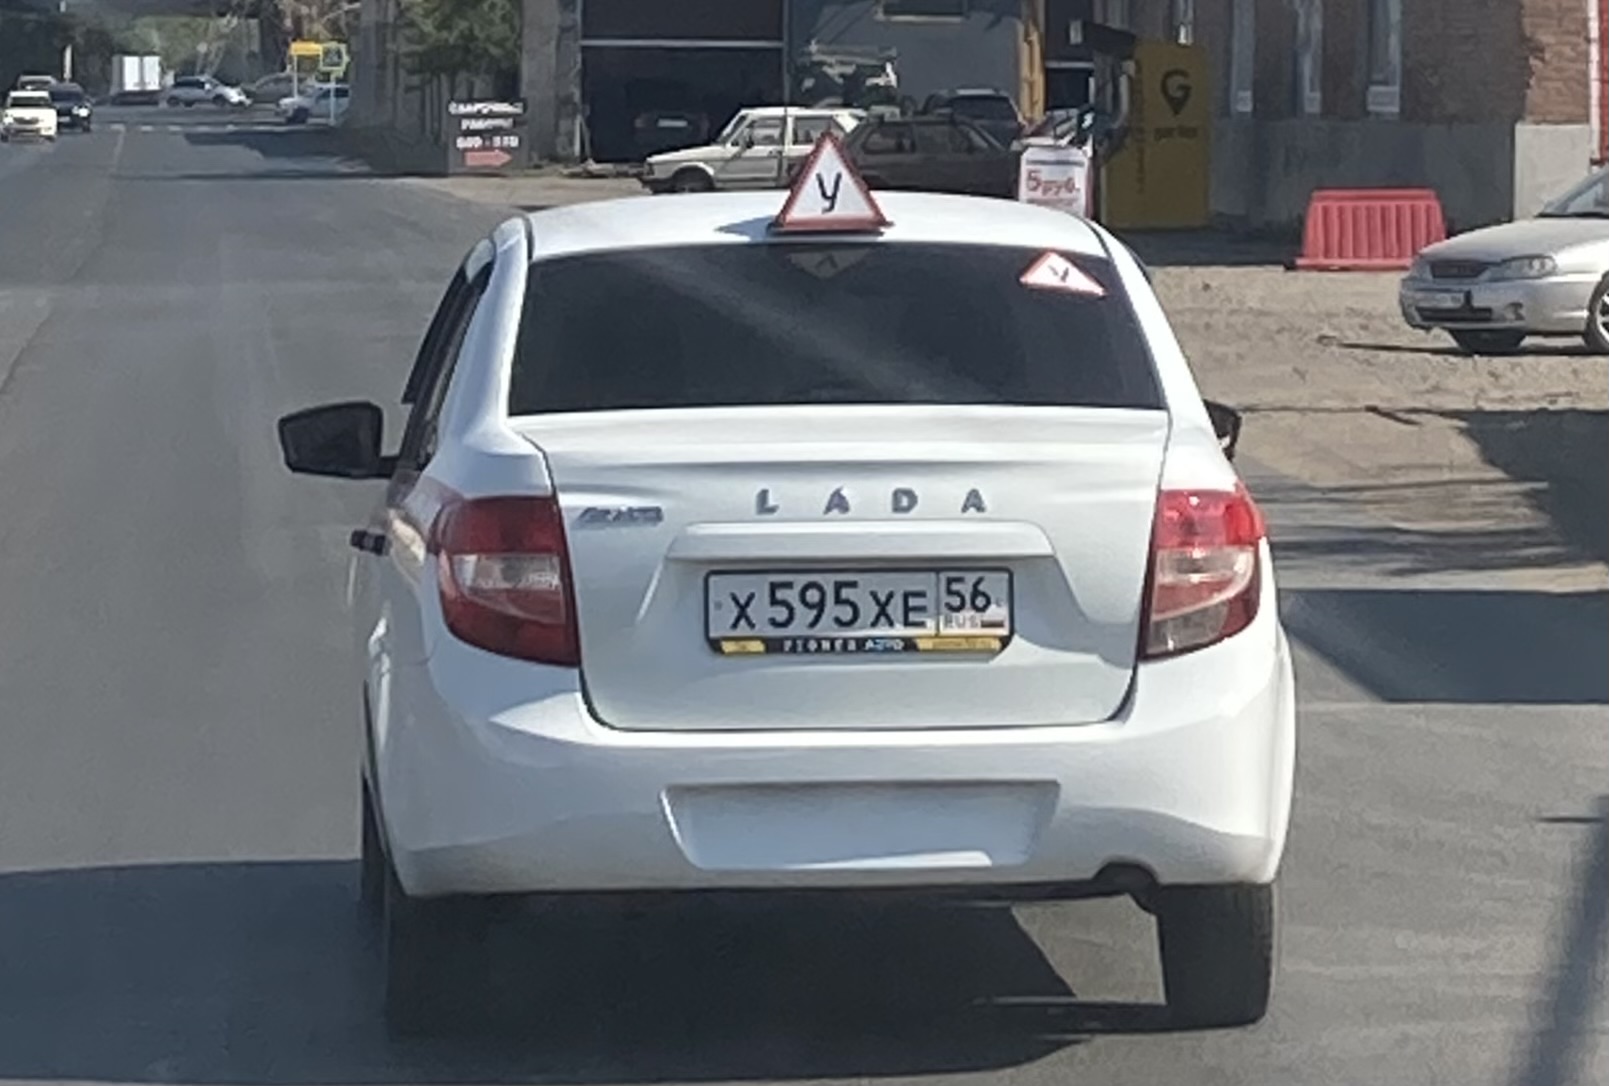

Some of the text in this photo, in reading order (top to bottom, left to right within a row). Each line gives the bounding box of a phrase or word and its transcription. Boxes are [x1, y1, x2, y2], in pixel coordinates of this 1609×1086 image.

[816, 171, 842, 214] У
[755, 487, 986, 515] LADA
[944, 576, 992, 613] 56
